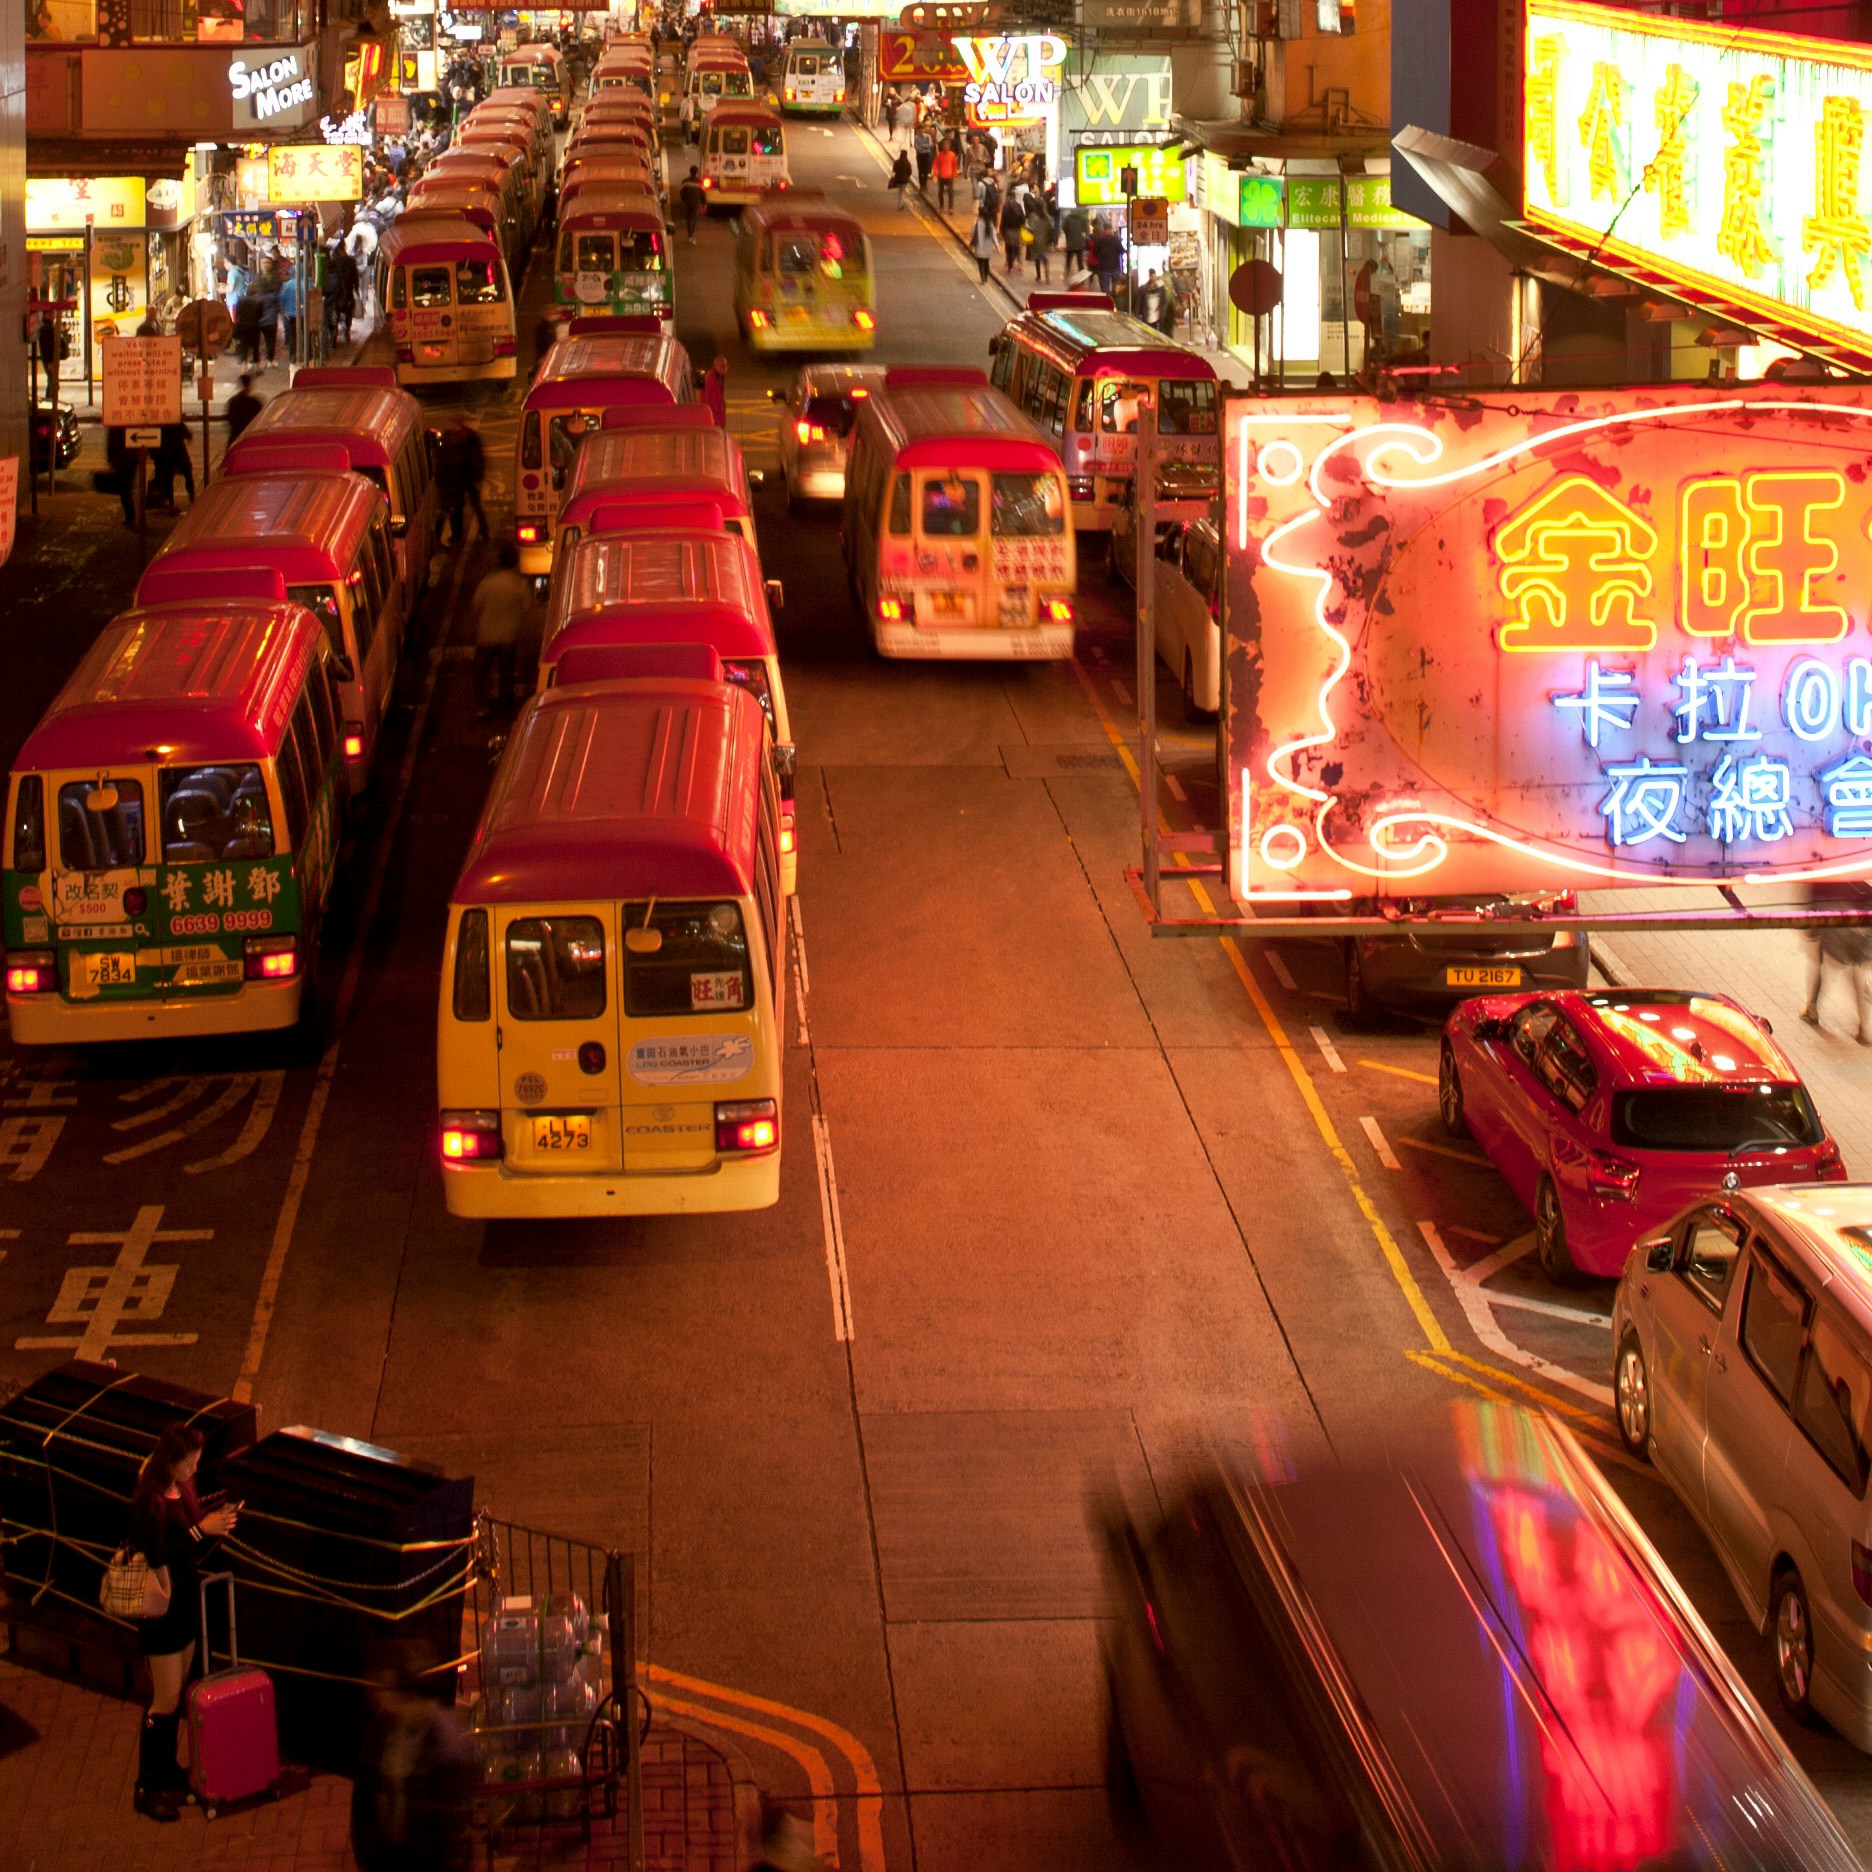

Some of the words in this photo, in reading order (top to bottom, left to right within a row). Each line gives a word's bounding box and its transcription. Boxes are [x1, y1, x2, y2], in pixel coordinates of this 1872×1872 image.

[950, 35, 1068, 86] WP
[229, 55, 298, 100] SALON
[255, 78, 314, 121] MORE
[964, 82, 1055, 104] SALON
[273, 150, 359, 178] 海天堂
[1136, 221, 1148, 230] 24
[1149, 221, 1164, 230] hrs
[1138, 230, 1161, 242] 全日
[111, 350, 144, 359] waiting
[163, 349, 173, 358] be
[107, 369, 140, 377] without
[161, 867, 281, 912] 葉謝鄧
[79, 902, 106, 915] $500
[170, 912, 220, 936] 6639
[223, 909, 273, 933] 9999
[99, 956, 121, 971] SW
[89, 968, 131, 983] 7834
[1453, 970, 1474, 983] TU
[1479, 970, 1514, 983] 2167
[661, 1058, 710, 1068] COASTER
[549, 1120, 576, 1134] LL
[624, 1124, 711, 1134] COASTER
[537, 1133, 589, 1149] 4273
